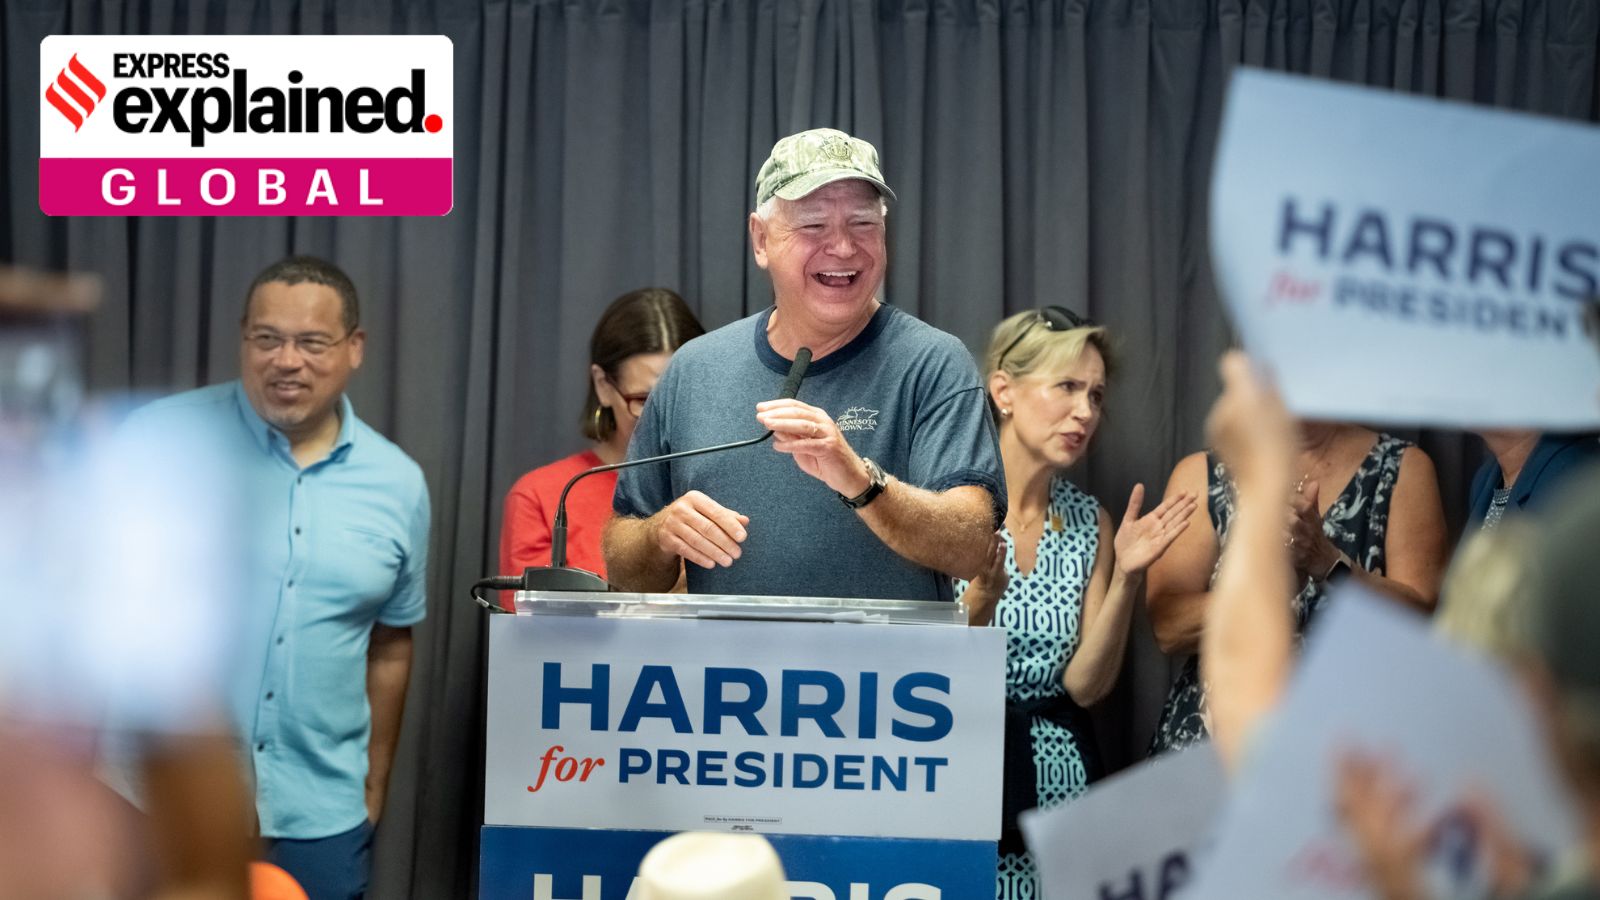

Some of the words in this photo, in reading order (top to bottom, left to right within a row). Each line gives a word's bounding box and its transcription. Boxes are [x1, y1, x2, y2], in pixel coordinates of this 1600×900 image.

[1276, 195, 1600, 301] HARRIS
[1333, 277, 1570, 340] PRESIDEN
[840, 424, 863, 432] ROWN
[541, 661, 954, 742] HARRIS
[527, 744, 605, 793] for
[618, 747, 948, 793] PRESIDENT
